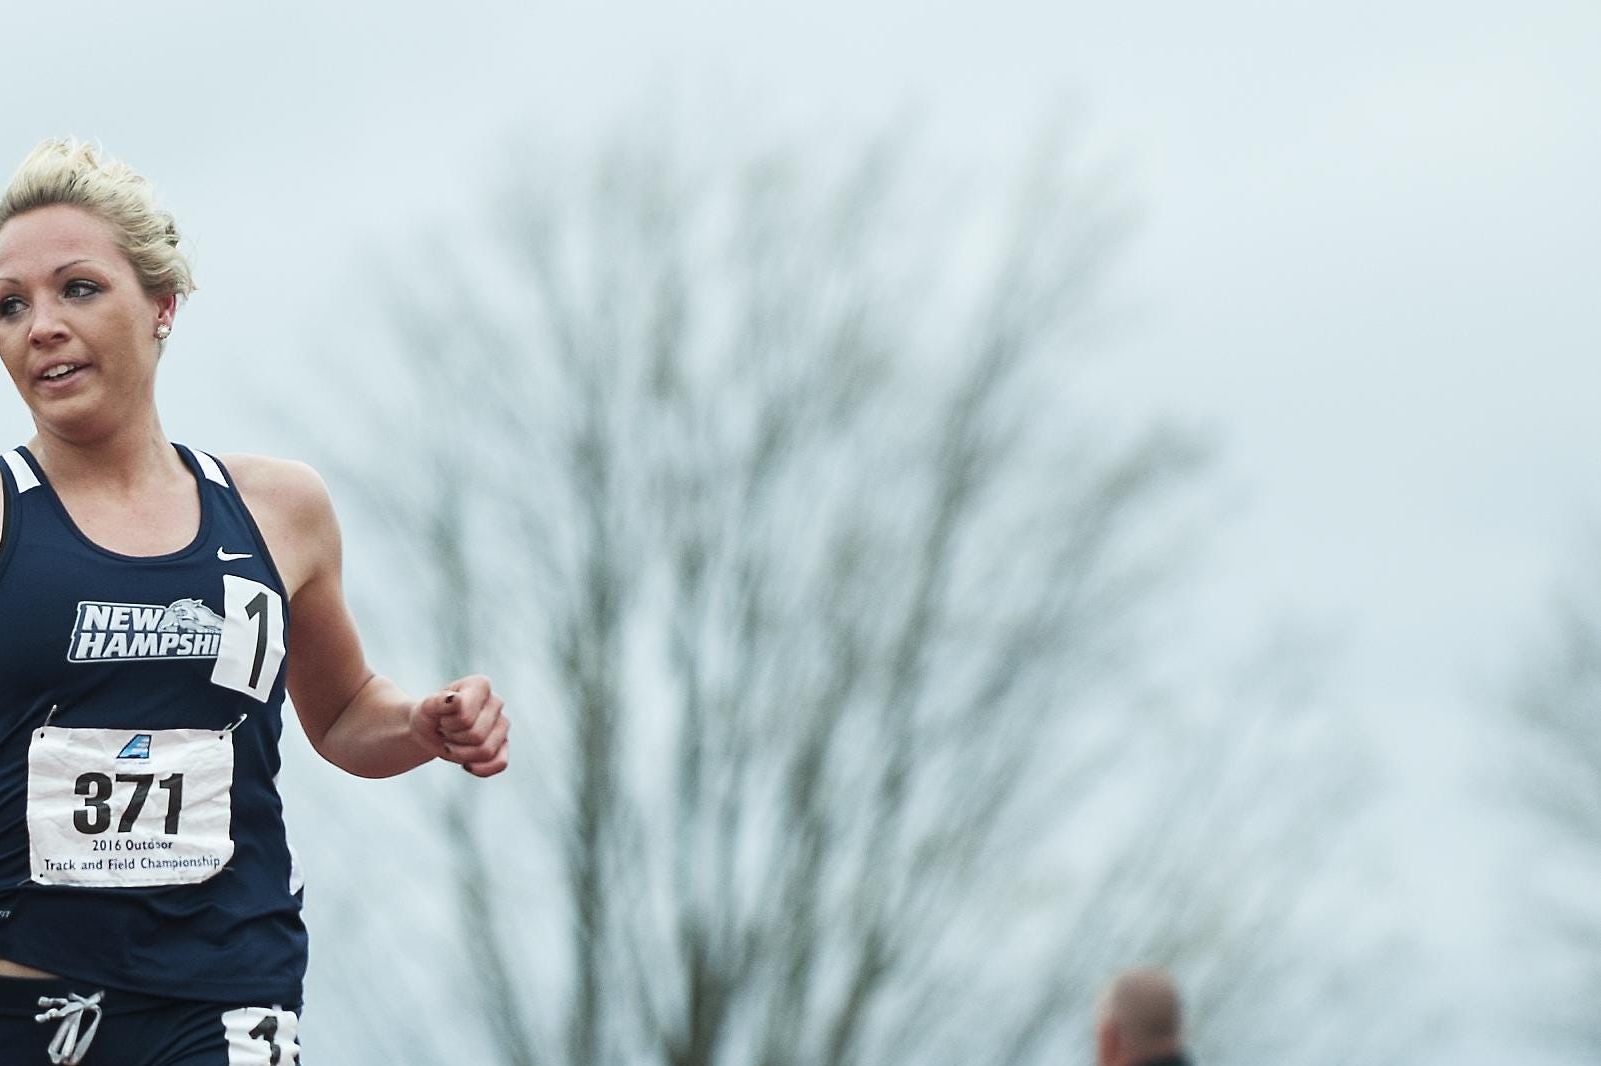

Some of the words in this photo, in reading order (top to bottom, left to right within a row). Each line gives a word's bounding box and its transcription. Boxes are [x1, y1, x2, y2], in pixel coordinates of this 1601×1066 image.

[82, 604, 166, 631] NEW
[75, 632, 221, 659] HAMPSHI
[244, 591, 269, 690] 1
[73, 772, 184, 834] 371
[92, 839, 122, 851] 2016
[125, 837, 174, 851] Outdoor
[44, 859, 76, 870] Track
[81, 859, 103, 870] and
[108, 858, 136, 870] Field
[140, 854, 221, 870] Championship
